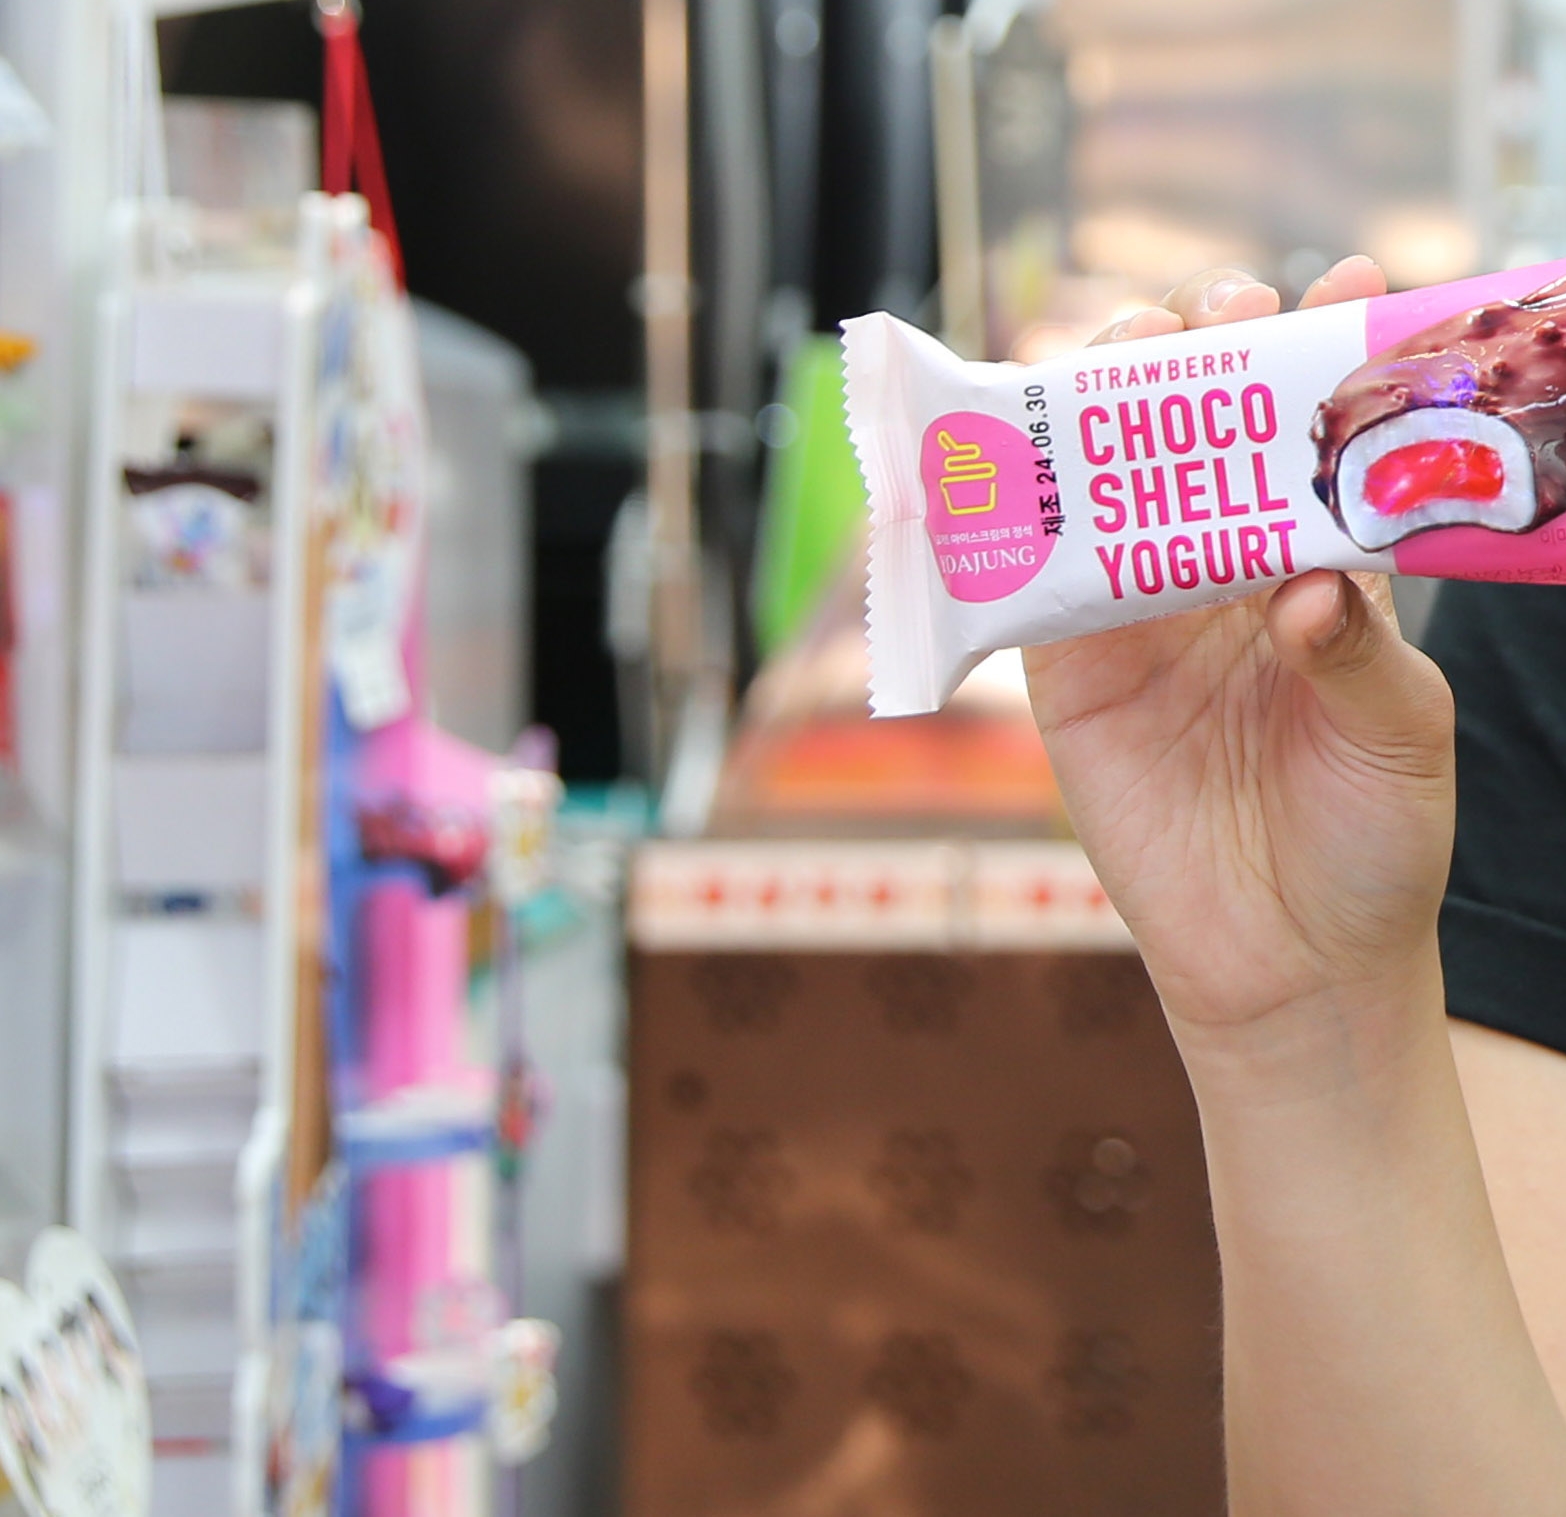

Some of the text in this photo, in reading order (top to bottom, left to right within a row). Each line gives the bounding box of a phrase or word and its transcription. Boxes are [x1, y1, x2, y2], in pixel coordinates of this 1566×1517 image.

[1075, 349, 1251, 393] STRAWBERRY
[1024, 384, 1066, 537] 제조 24.06.30
[1078, 382, 1278, 466] CHOCO
[1089, 452, 1289, 533] SHELL
[950, 527, 1010, 545] 아이스크림의
[1011, 524, 1034, 540] 정석
[1095, 519, 1297, 600] YOGURT
